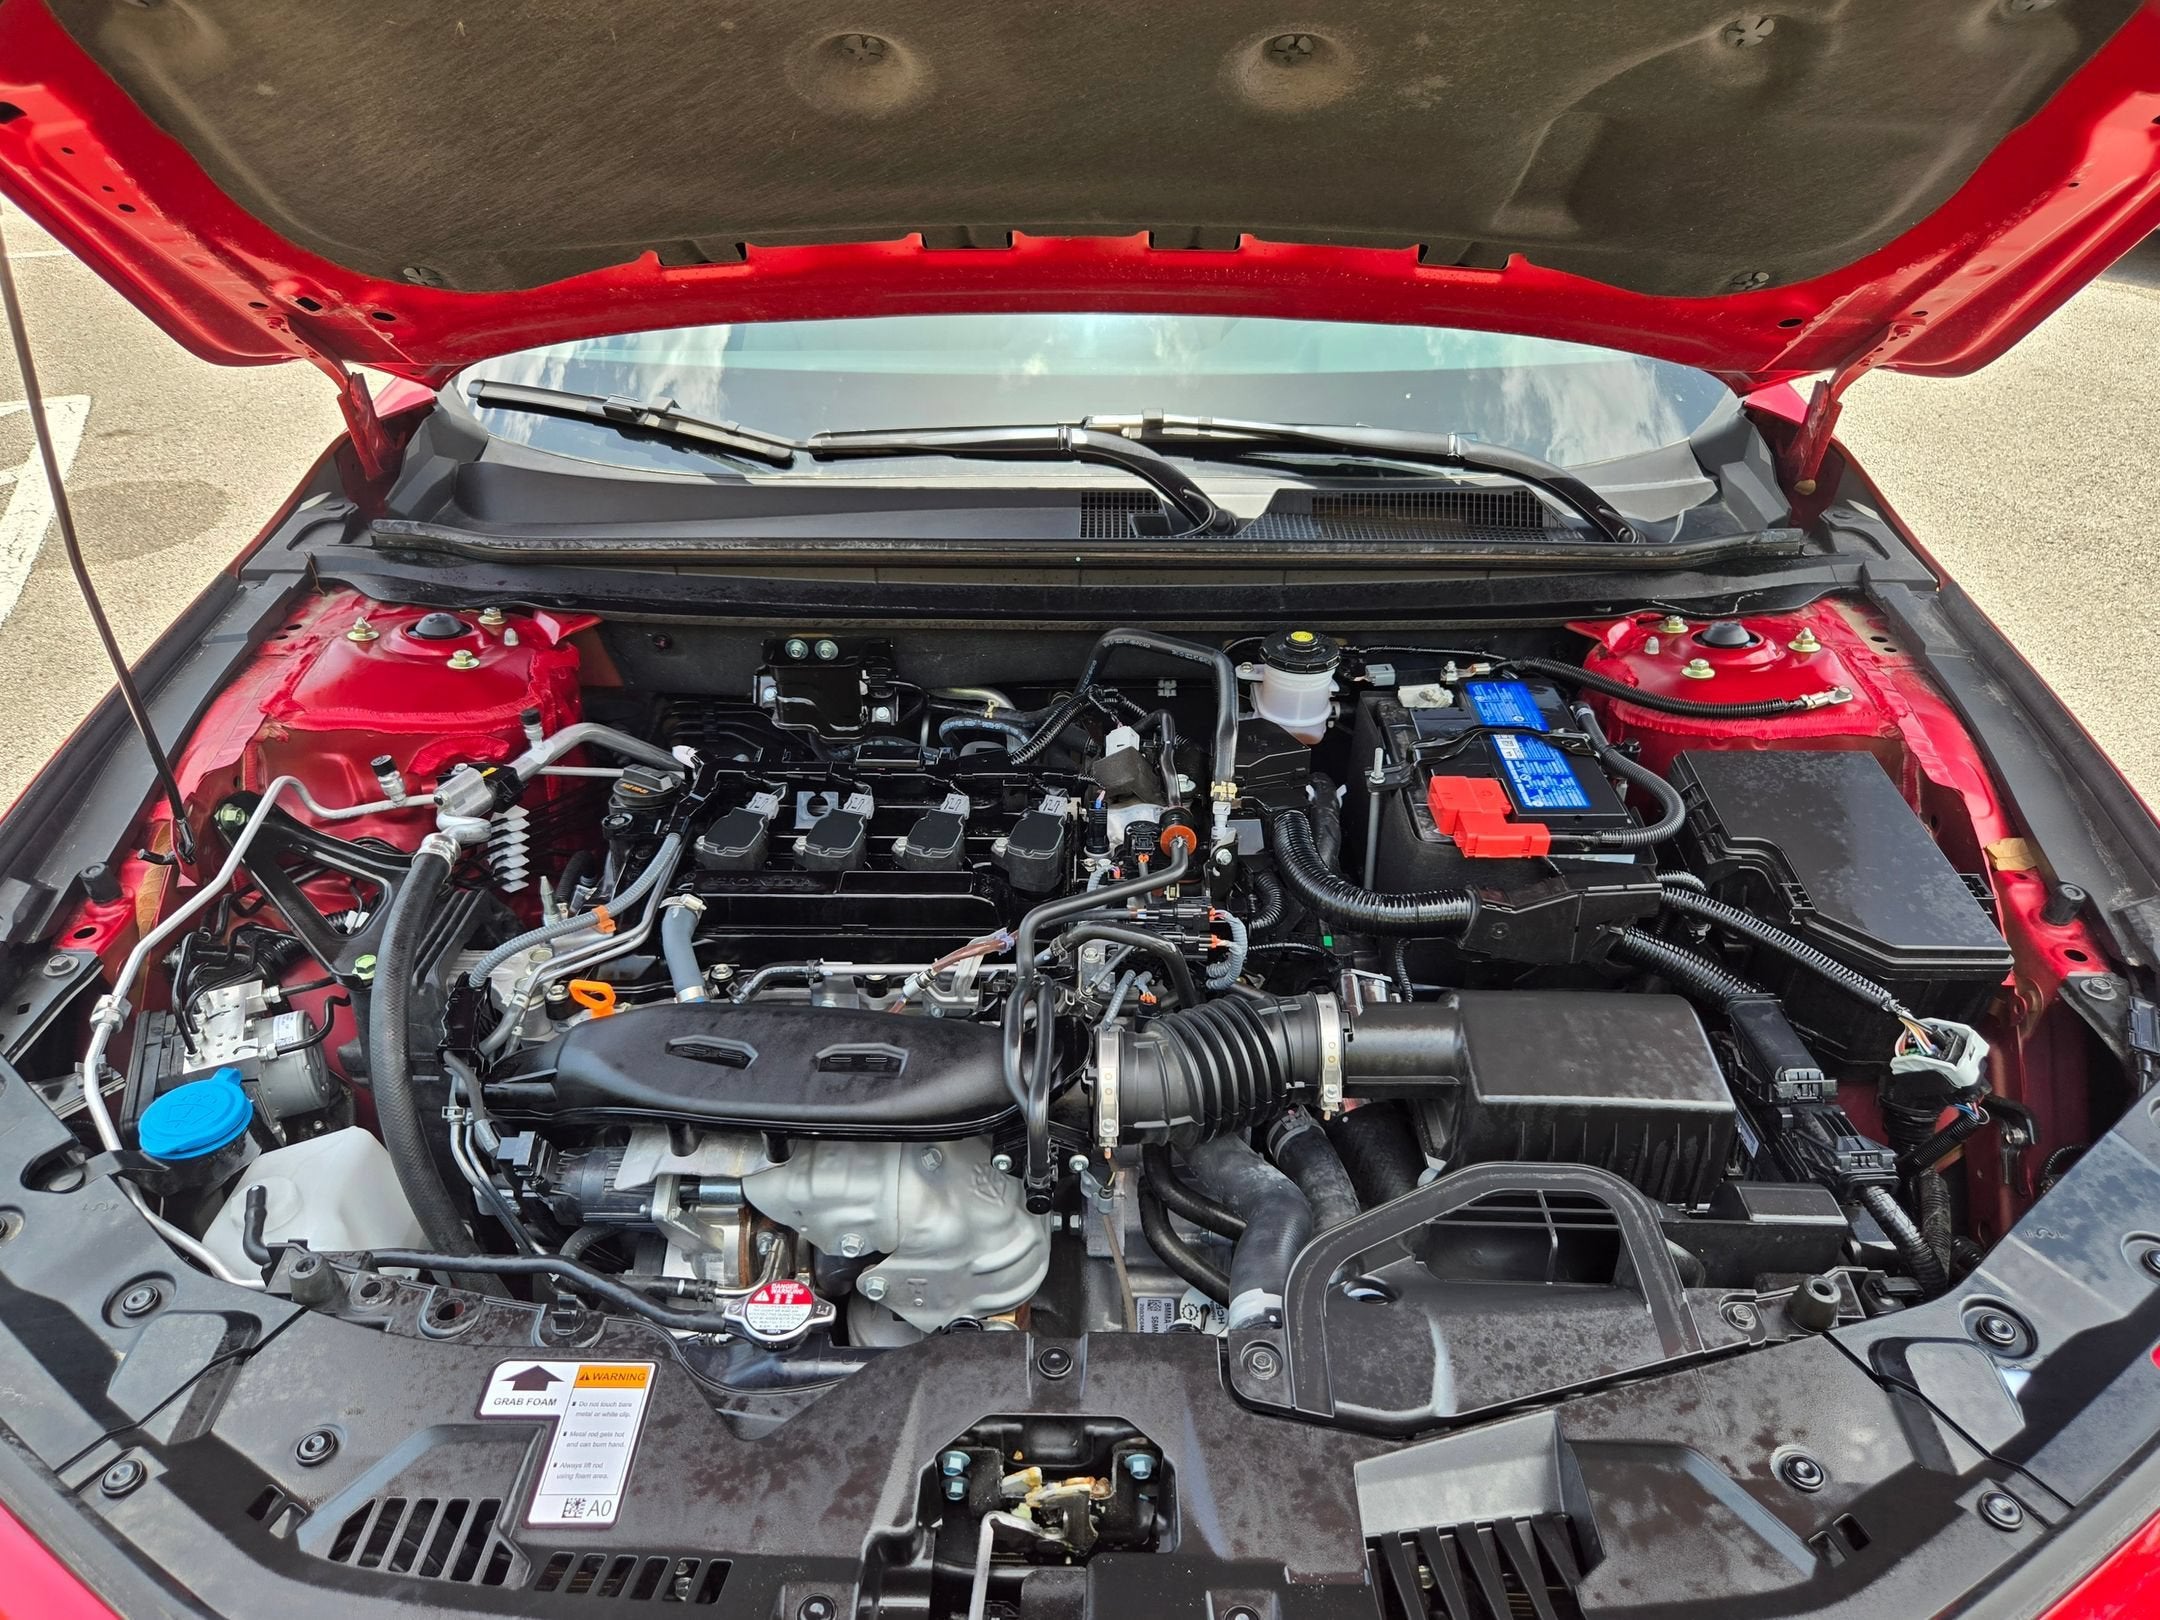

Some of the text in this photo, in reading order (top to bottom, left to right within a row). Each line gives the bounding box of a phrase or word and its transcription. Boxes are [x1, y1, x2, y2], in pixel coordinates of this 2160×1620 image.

[592, 1372, 646, 1381] WARNING
[493, 1397, 557, 1406] GRAB FOAM
[586, 1499, 612, 1517] A0
